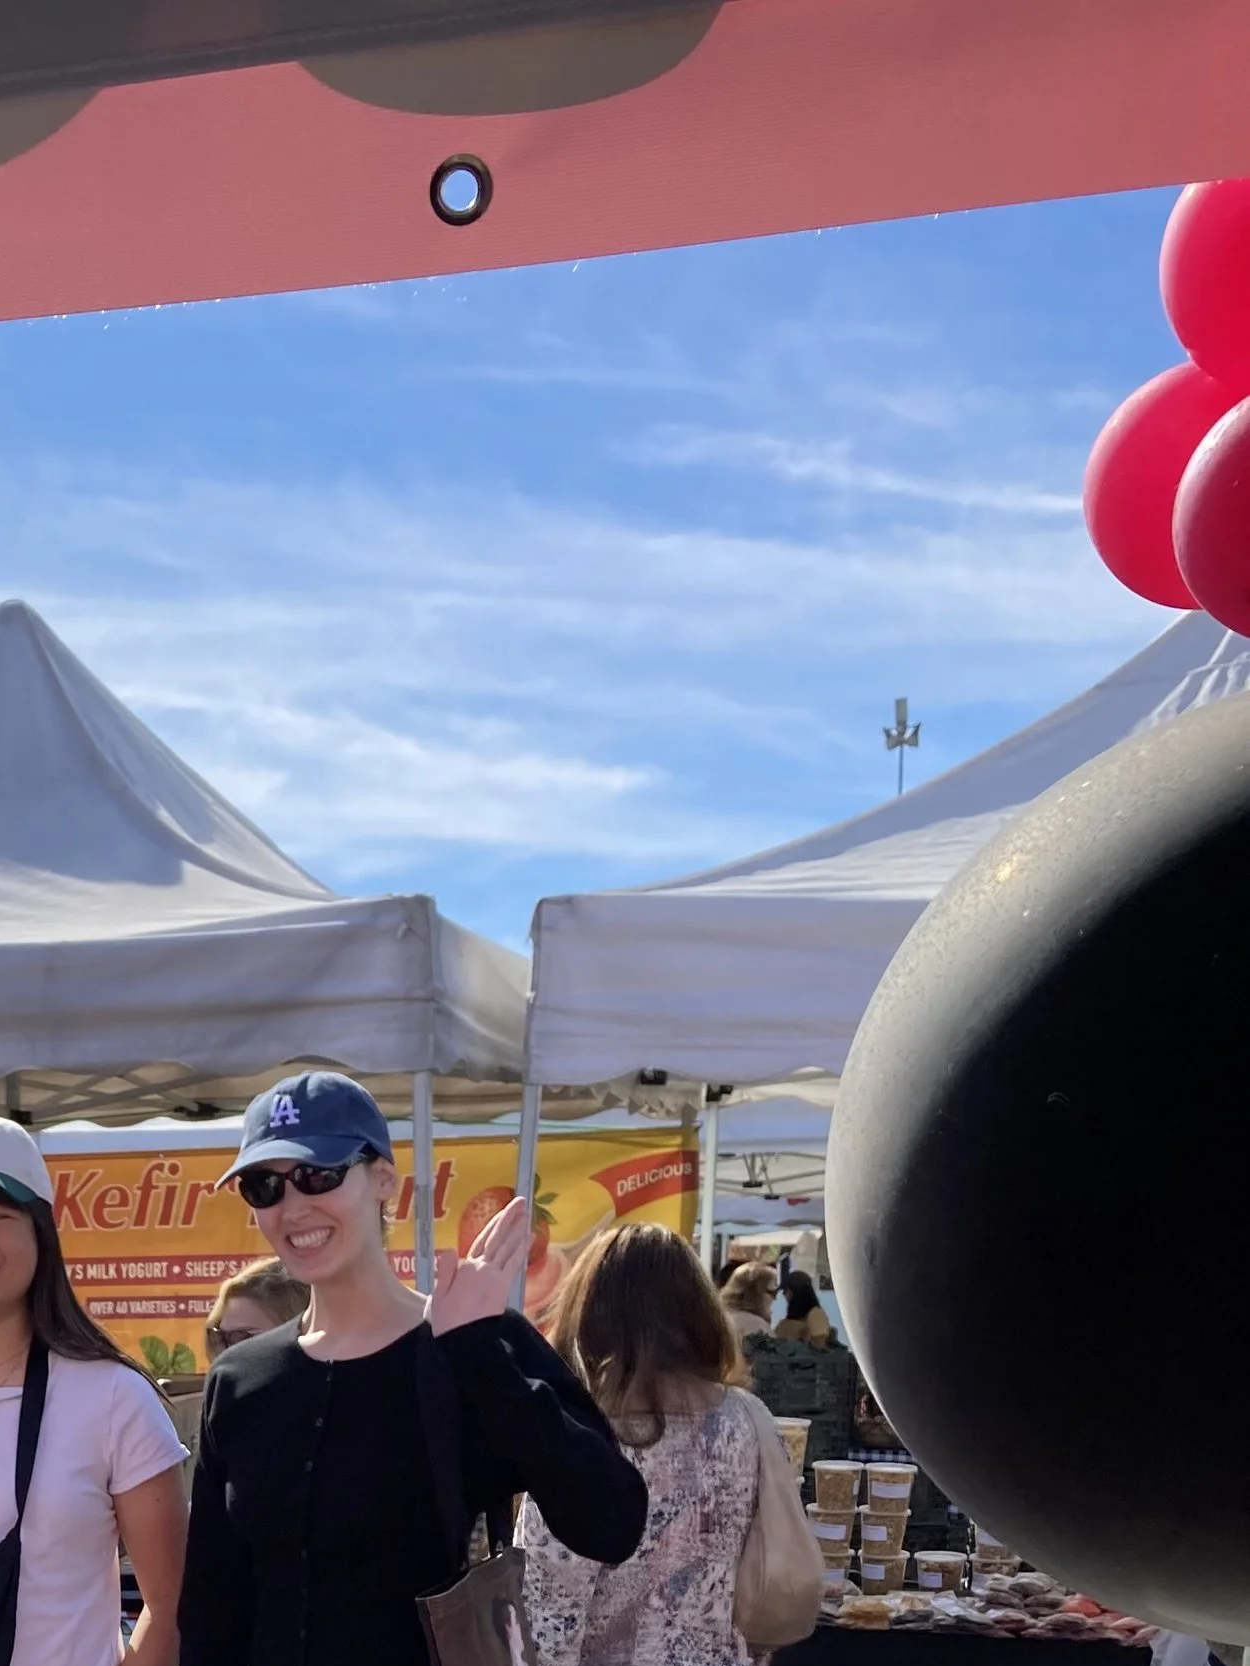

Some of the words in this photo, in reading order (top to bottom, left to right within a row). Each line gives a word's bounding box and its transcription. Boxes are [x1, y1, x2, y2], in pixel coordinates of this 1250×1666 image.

[269, 1094, 300, 1128] LA
[51, 1160, 218, 1232] Kefir
[616, 1162, 692, 1198] DELICIOUS
[86, 1263, 117, 1280] MILK
[121, 1261, 168, 1279] YOGURT
[185, 1260, 238, 1277] SHEEP'S
[89, 1301, 114, 1315] OVER
[130, 1300, 176, 1314] VARIETIES
